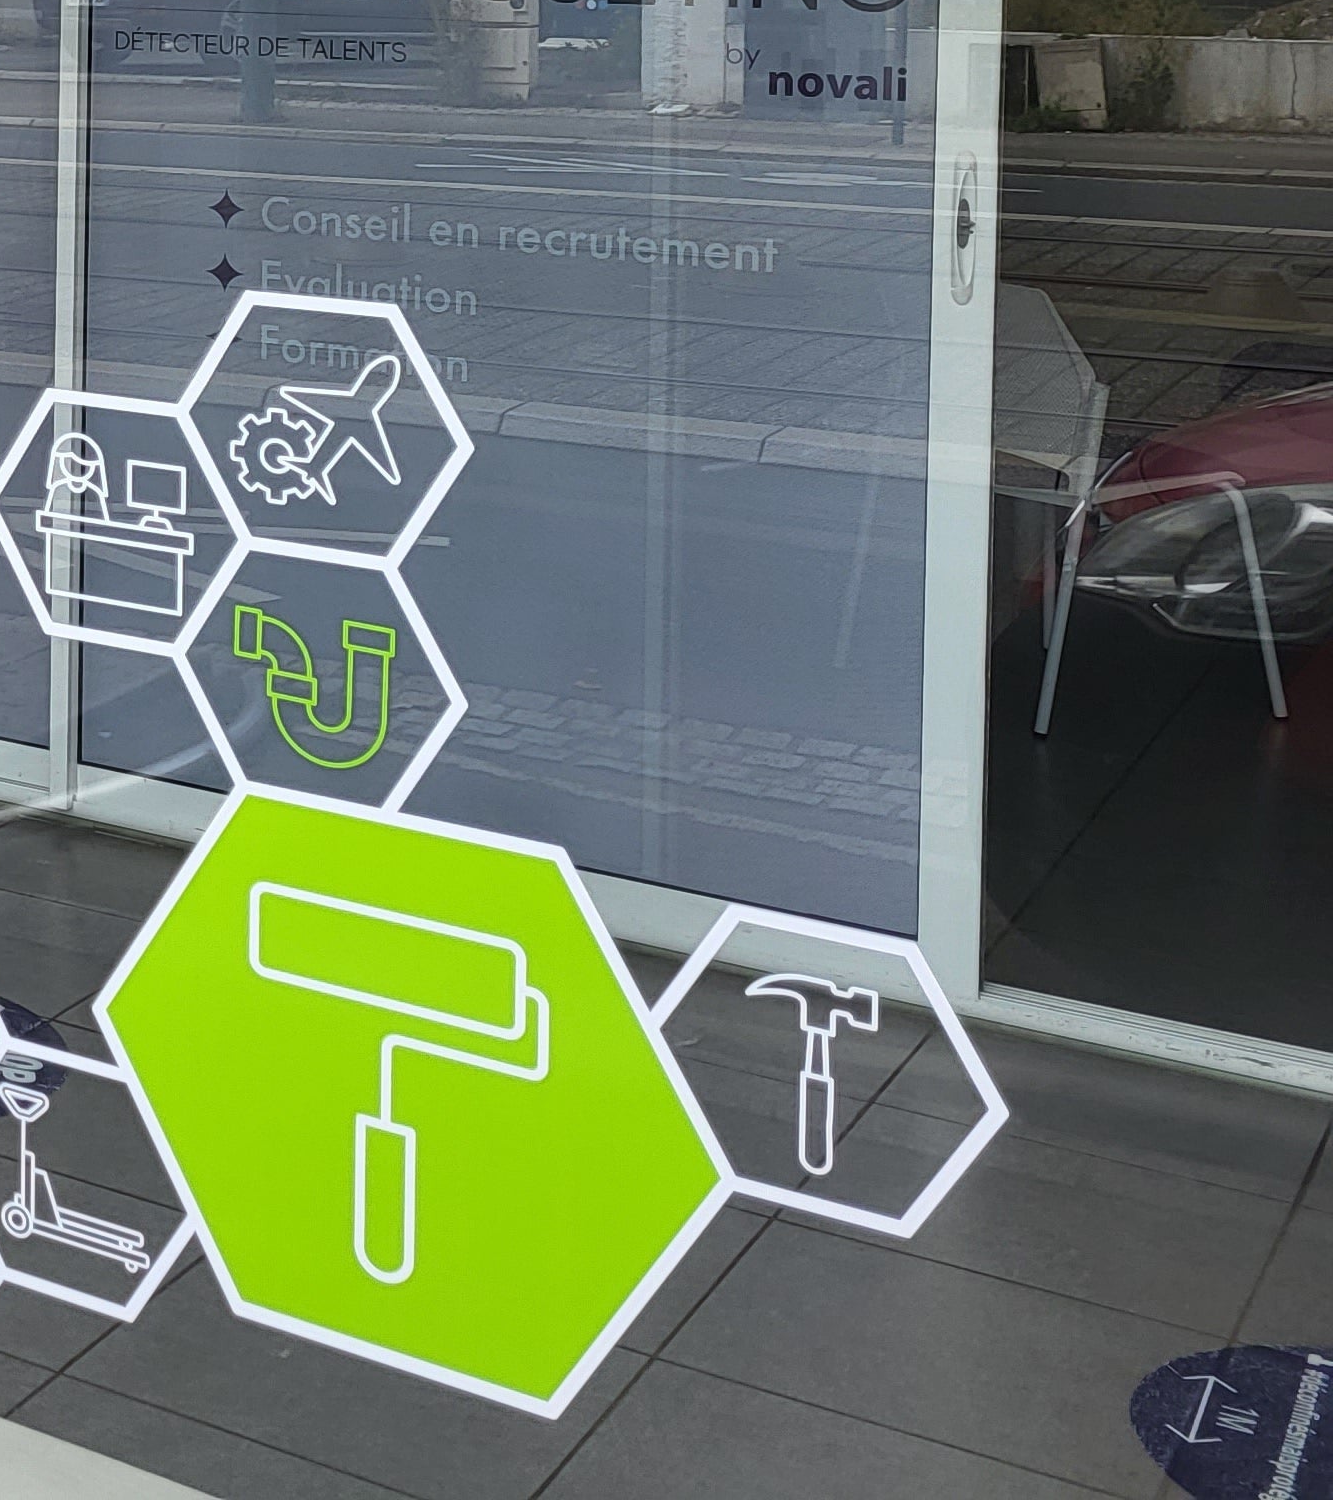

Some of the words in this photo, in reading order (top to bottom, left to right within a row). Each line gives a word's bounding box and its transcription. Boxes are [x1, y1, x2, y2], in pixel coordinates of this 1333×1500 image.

[115, 27, 251, 61] DÉTECTEUR
[256, 37, 294, 60] DE
[298, 35, 408, 64] TALENTS
[726, 43, 762, 70] by
[767, 65, 908, 102] novali
[261, 196, 413, 244] Conseil
[429, 218, 479, 250] en
[499, 221, 779, 275] recrutement
[1215, 1404, 1260, 1435] 1M
